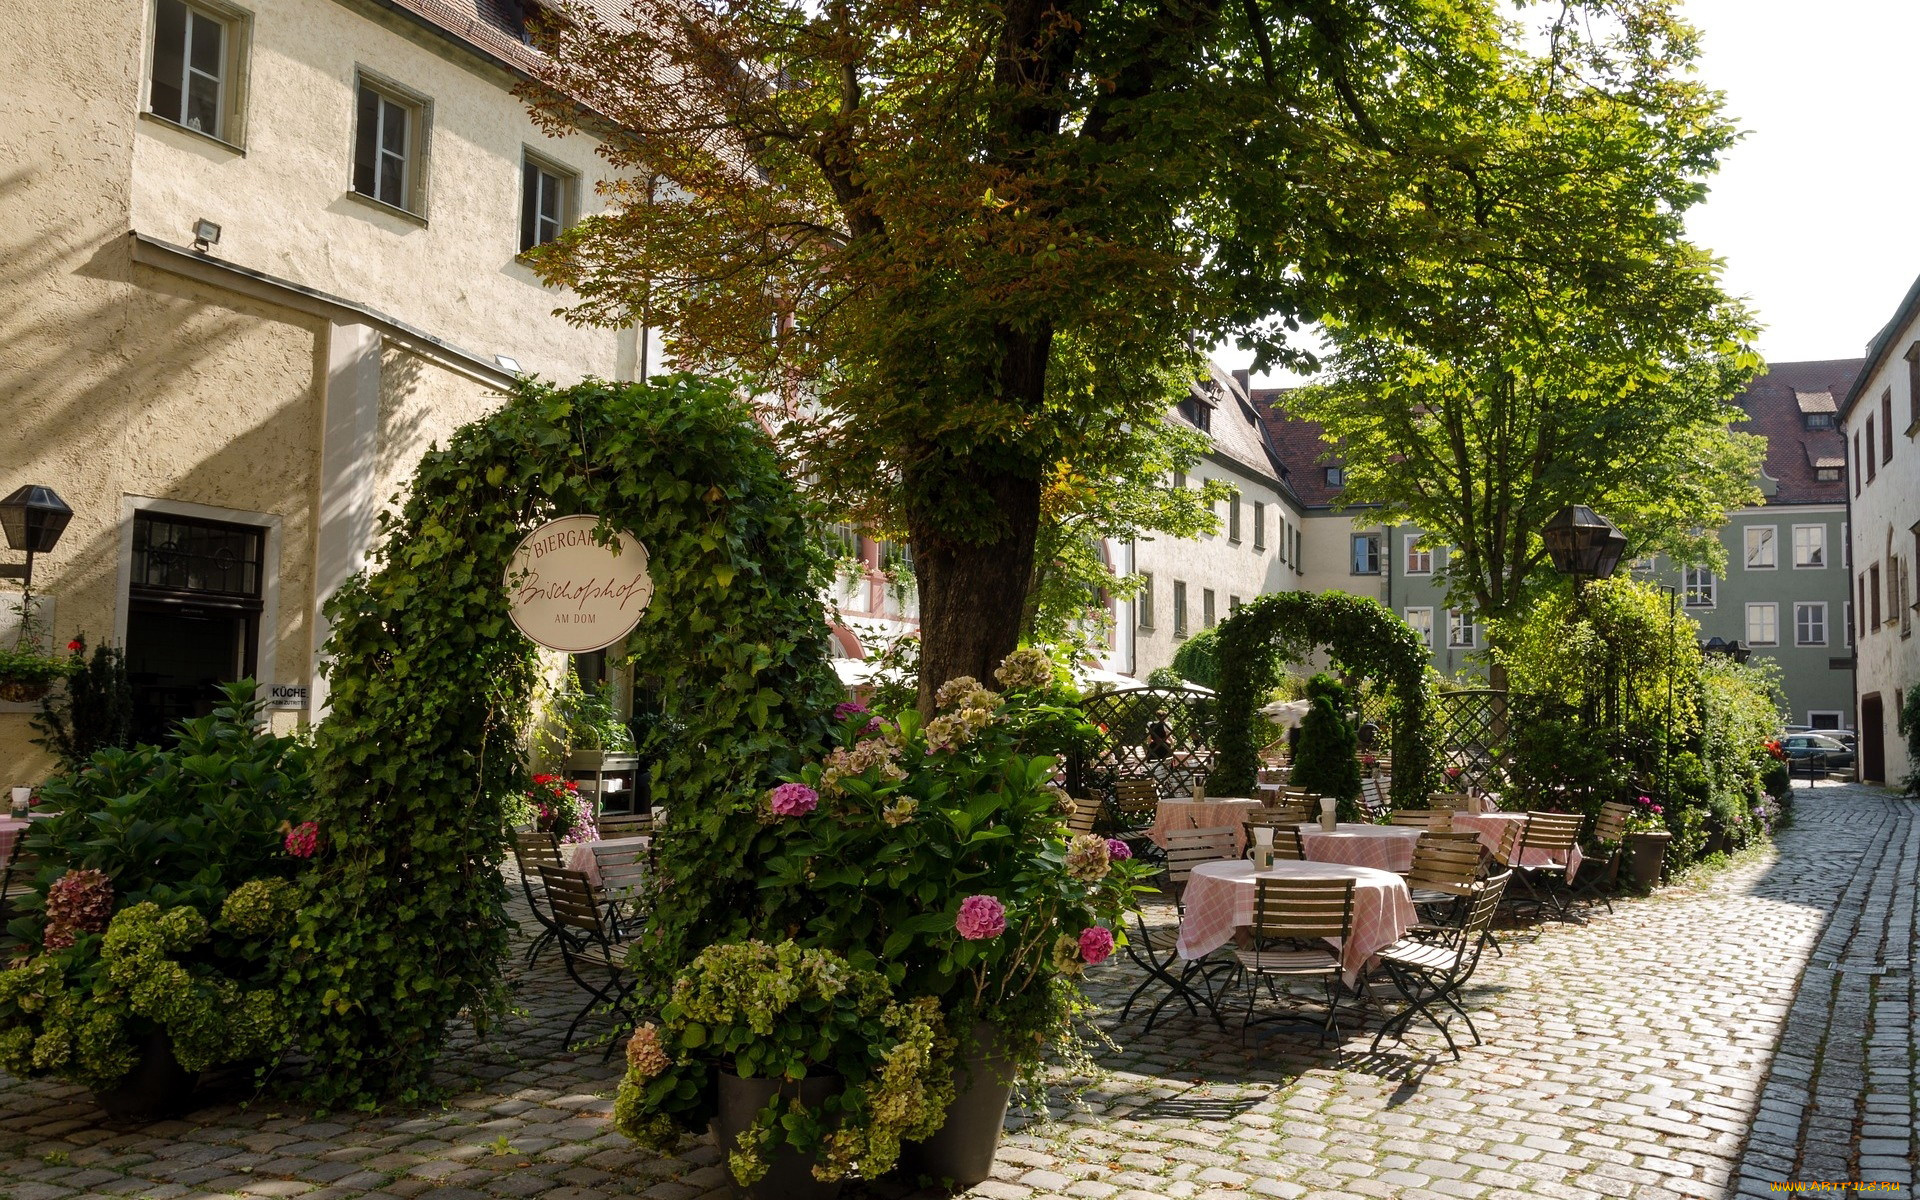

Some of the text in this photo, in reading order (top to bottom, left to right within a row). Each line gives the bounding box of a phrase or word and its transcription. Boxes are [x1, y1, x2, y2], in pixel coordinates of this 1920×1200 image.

[533, 529, 625, 558] BIERGARN
[554, 613, 596, 624] AM DOM
[272, 686, 306, 698] KÜCHE
